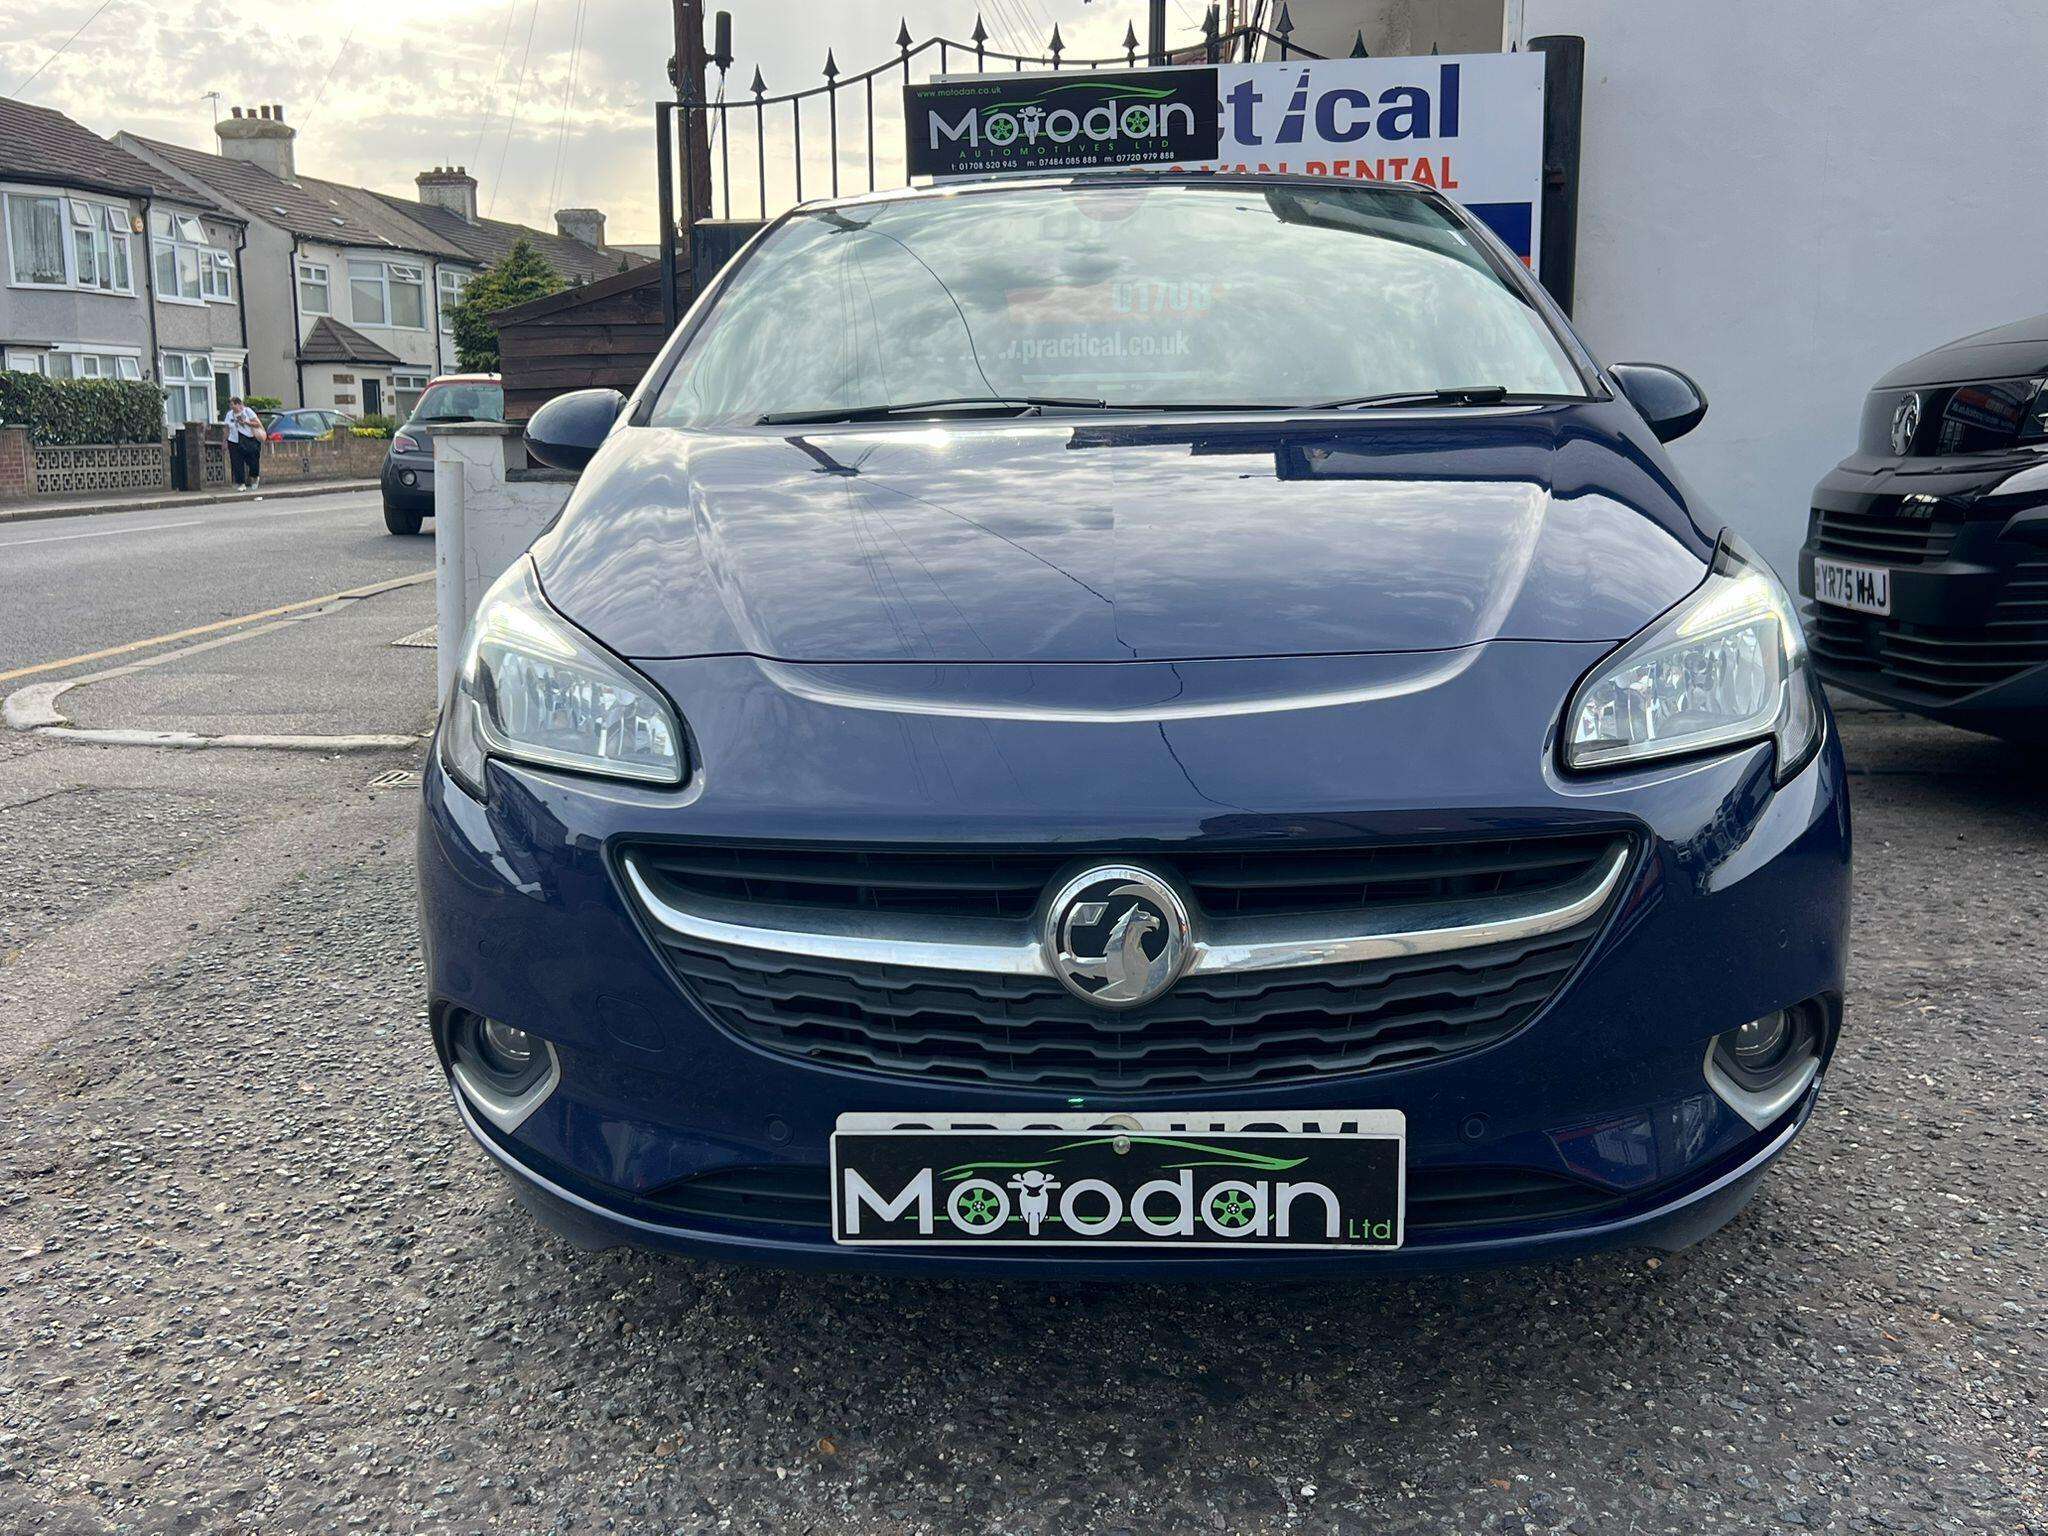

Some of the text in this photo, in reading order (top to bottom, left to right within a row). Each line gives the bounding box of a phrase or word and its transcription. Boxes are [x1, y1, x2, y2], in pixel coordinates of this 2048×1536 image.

[916, 86, 1002, 98] www.motodan.co.uk
[928, 100, 1195, 150] Motodan
[959, 140, 1170, 159] AUTOMOTIVES LTD
[959, 161, 983, 171] 01708
[985, 160, 1000, 169] 520
[1002, 159, 1018, 168] 945
[1116, 153, 1141, 163] 07720
[1821, 563, 1887, 608] YR75 WAJ
[844, 1168, 1391, 1239] Motodan Ltd
